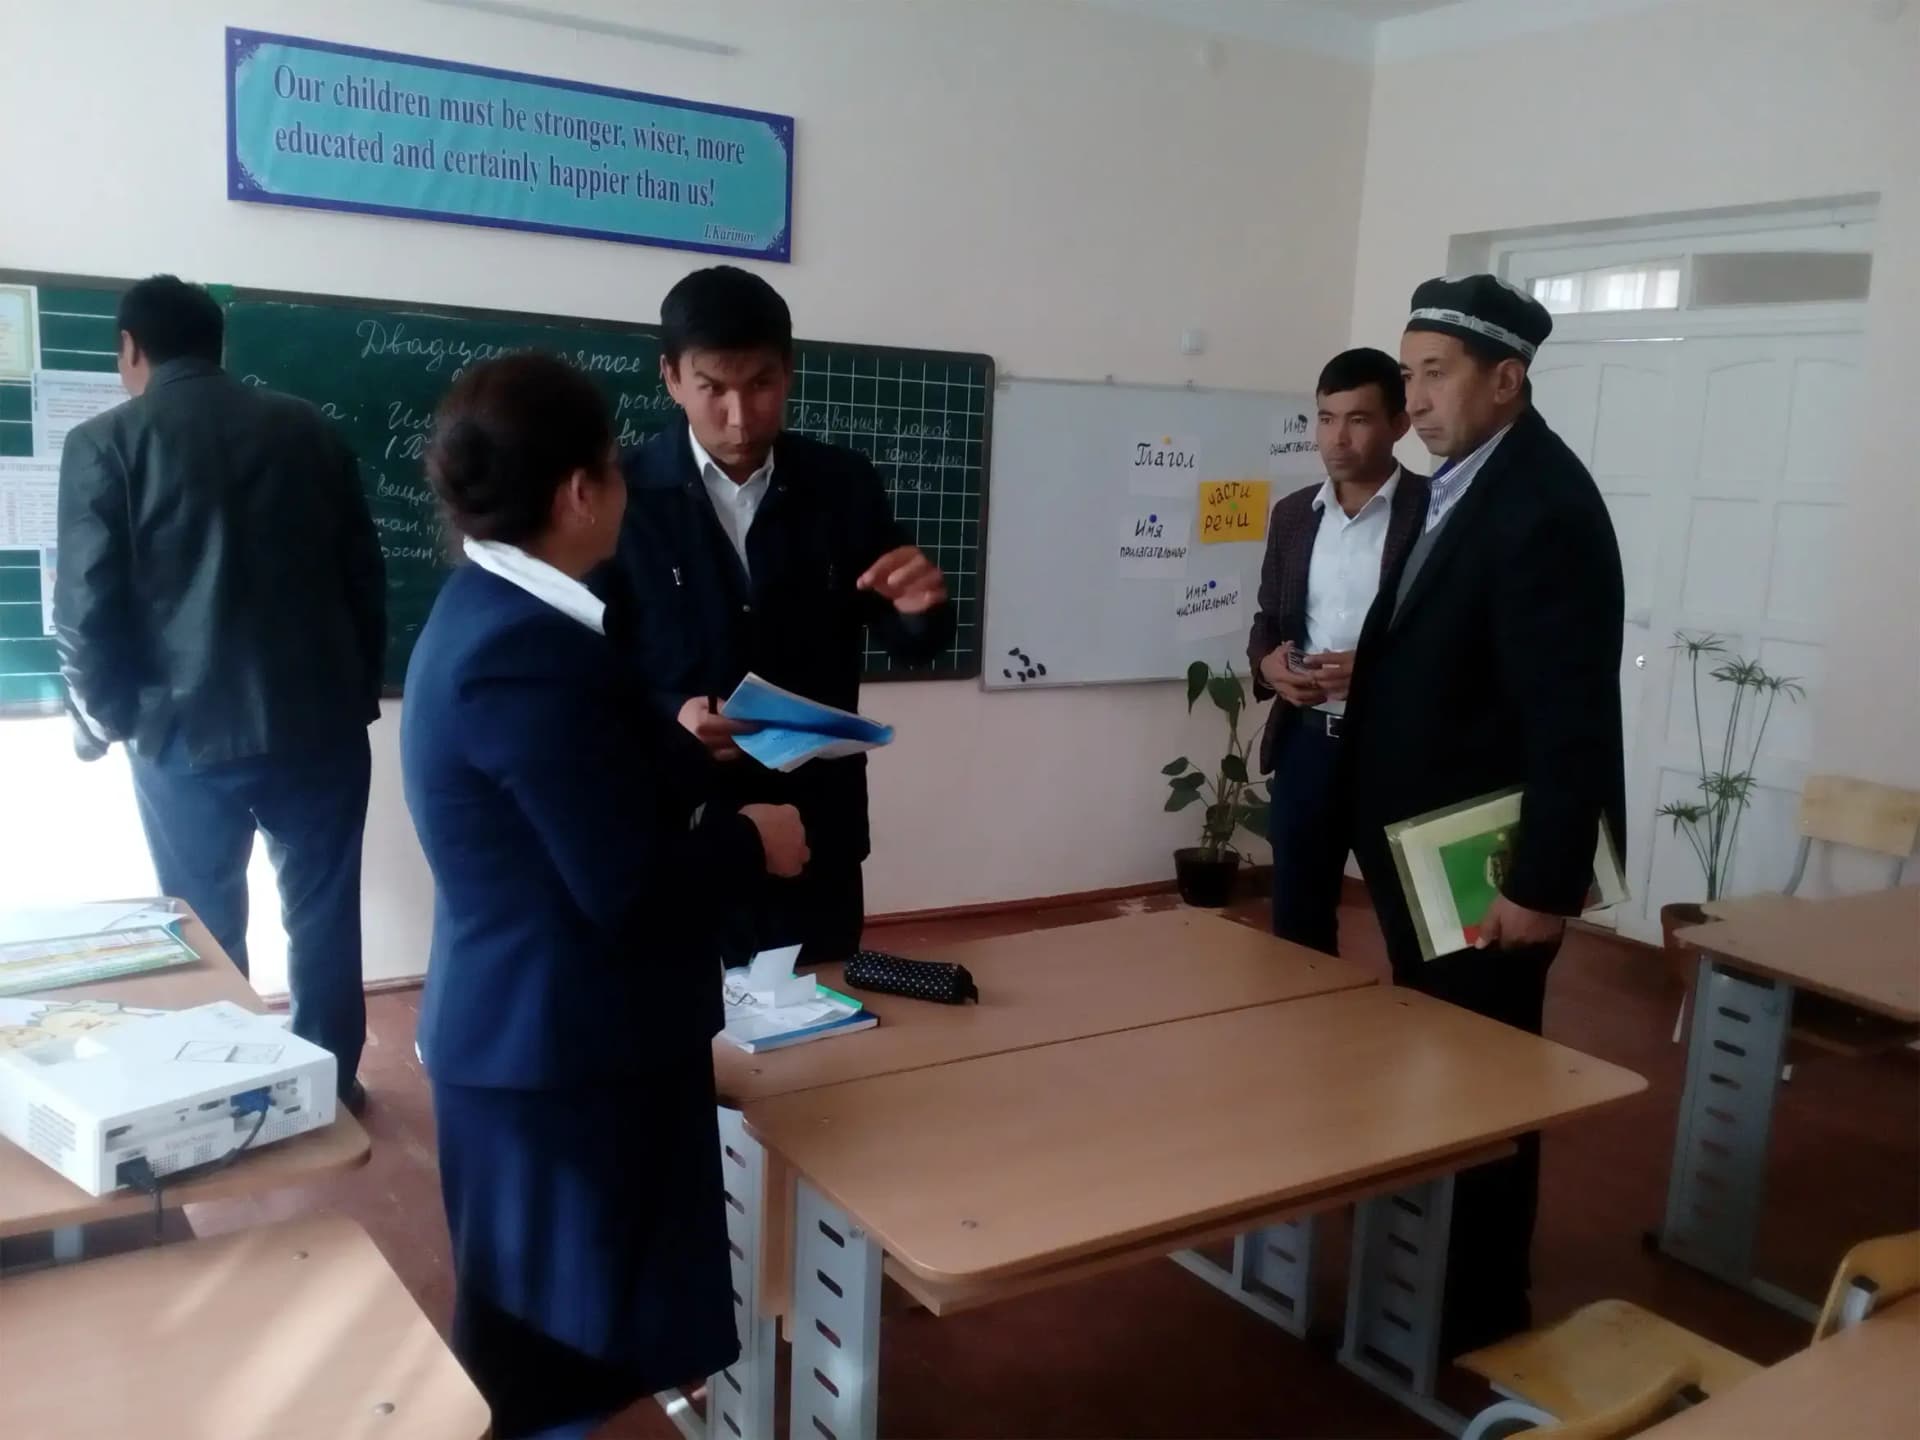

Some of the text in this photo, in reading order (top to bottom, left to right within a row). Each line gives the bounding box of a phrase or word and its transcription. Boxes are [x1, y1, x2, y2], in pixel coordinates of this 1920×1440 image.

[273, 63, 746, 164] Our children must be stronger, wiser, more
[275, 122, 716, 207] educated and certainly happier than us!
[1134, 442, 1197, 469] Глагол
[1134, 519, 1164, 539] Имя
